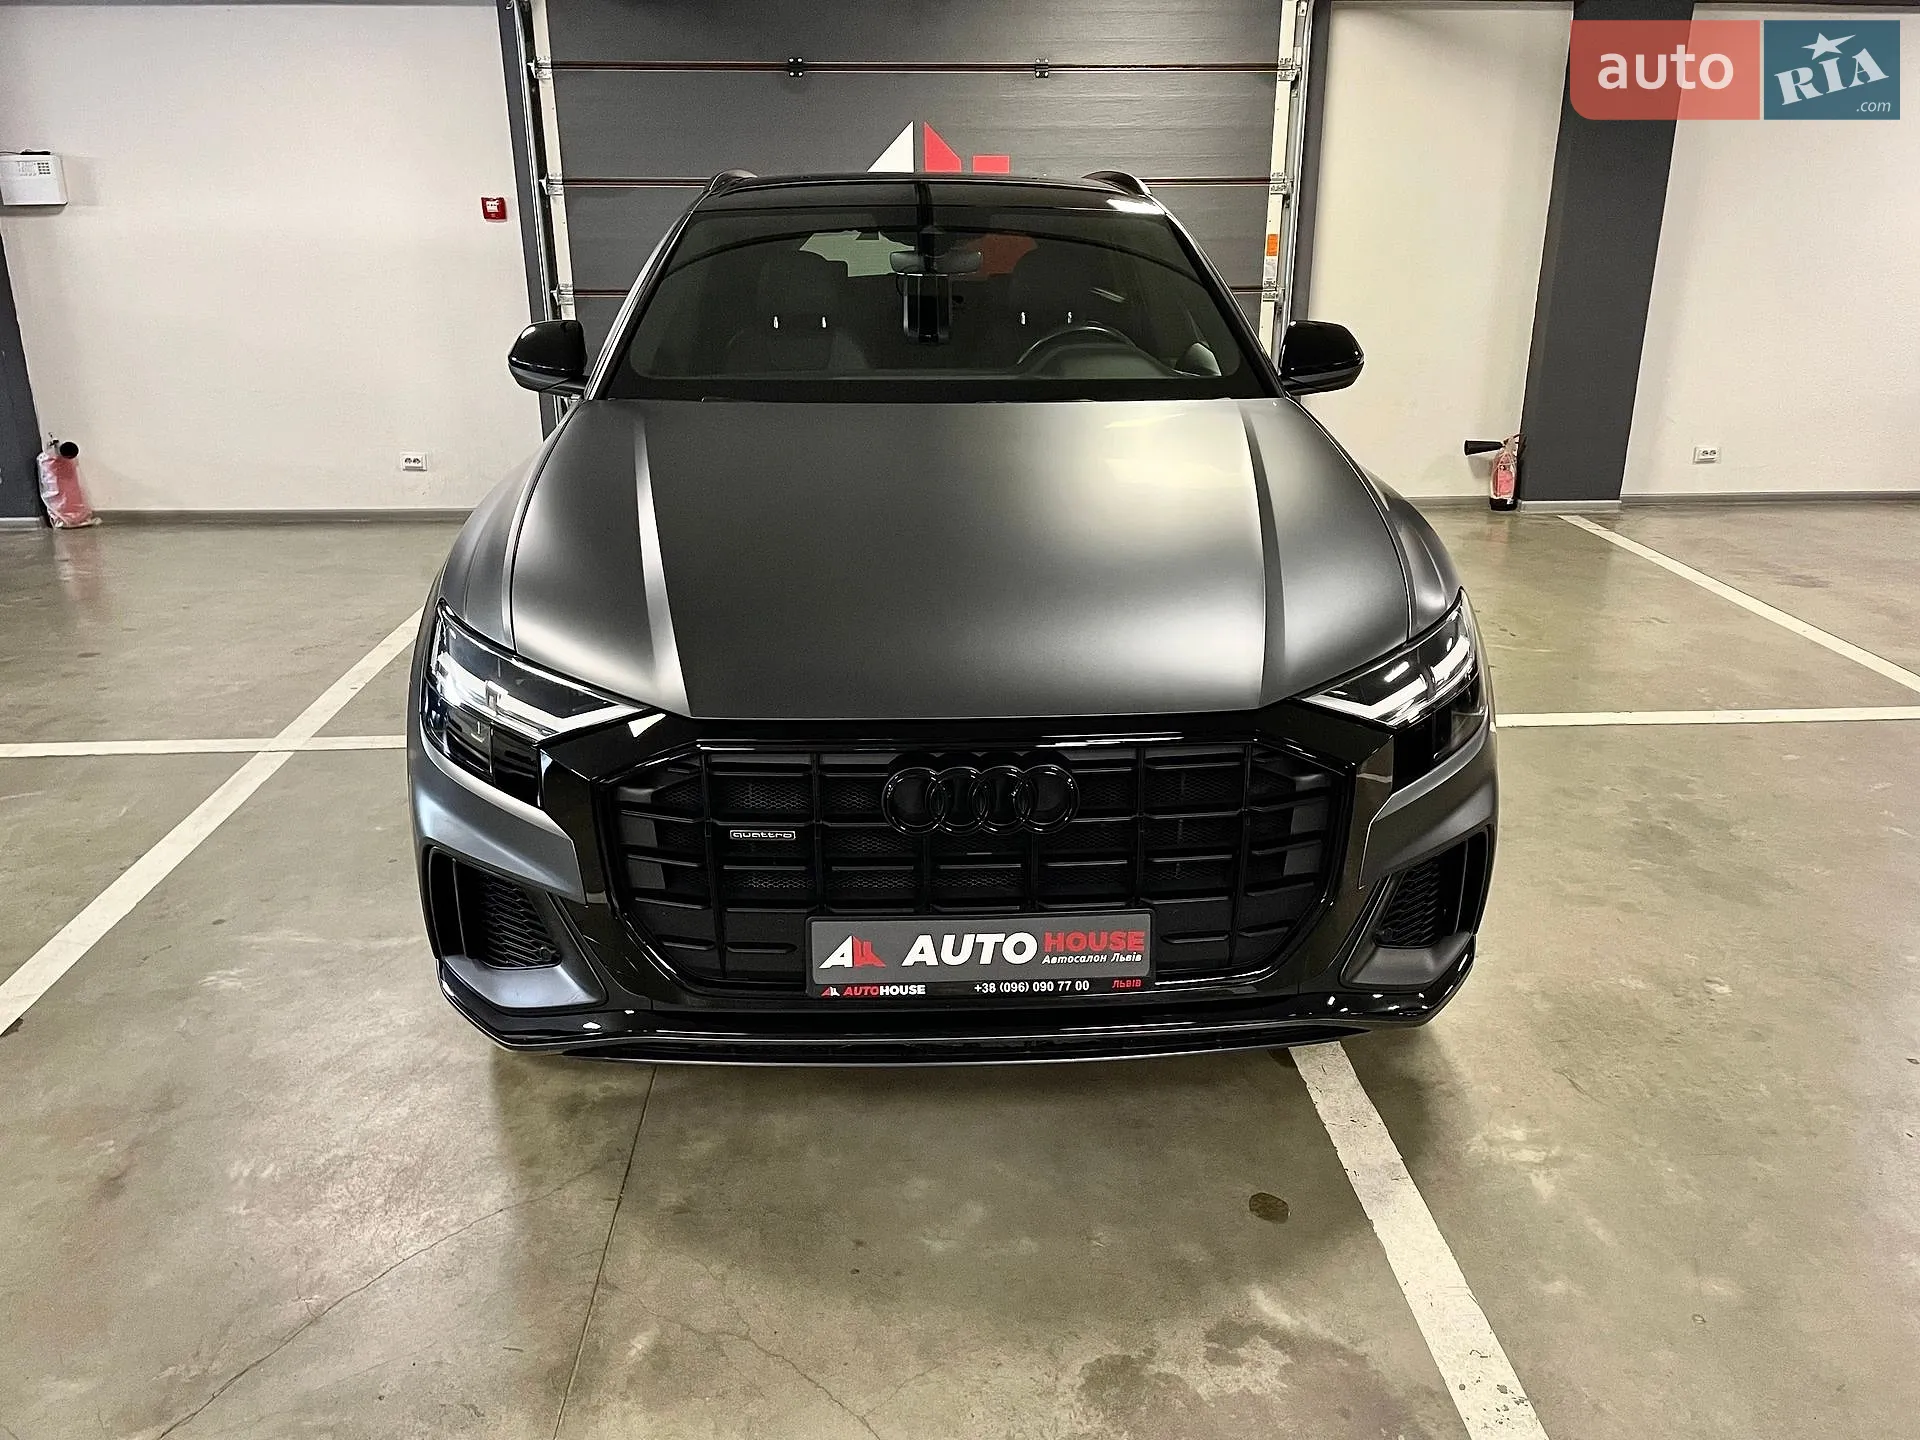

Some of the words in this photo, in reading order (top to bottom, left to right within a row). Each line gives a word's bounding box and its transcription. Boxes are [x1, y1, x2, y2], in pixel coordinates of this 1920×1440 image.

[732, 831, 793, 839] quattro
[901, 932, 1038, 966] AUTO
[1044, 931, 1145, 952] HOUSE
[1041, 954, 1107, 965] Автосалон
[1110, 952, 1142, 963] Львів
[974, 982, 997, 993] +38
[999, 981, 1030, 994] (096)
[1032, 981, 1054, 992] 090
[1057, 980, 1072, 992] 77
[1074, 980, 1090, 991] 00
